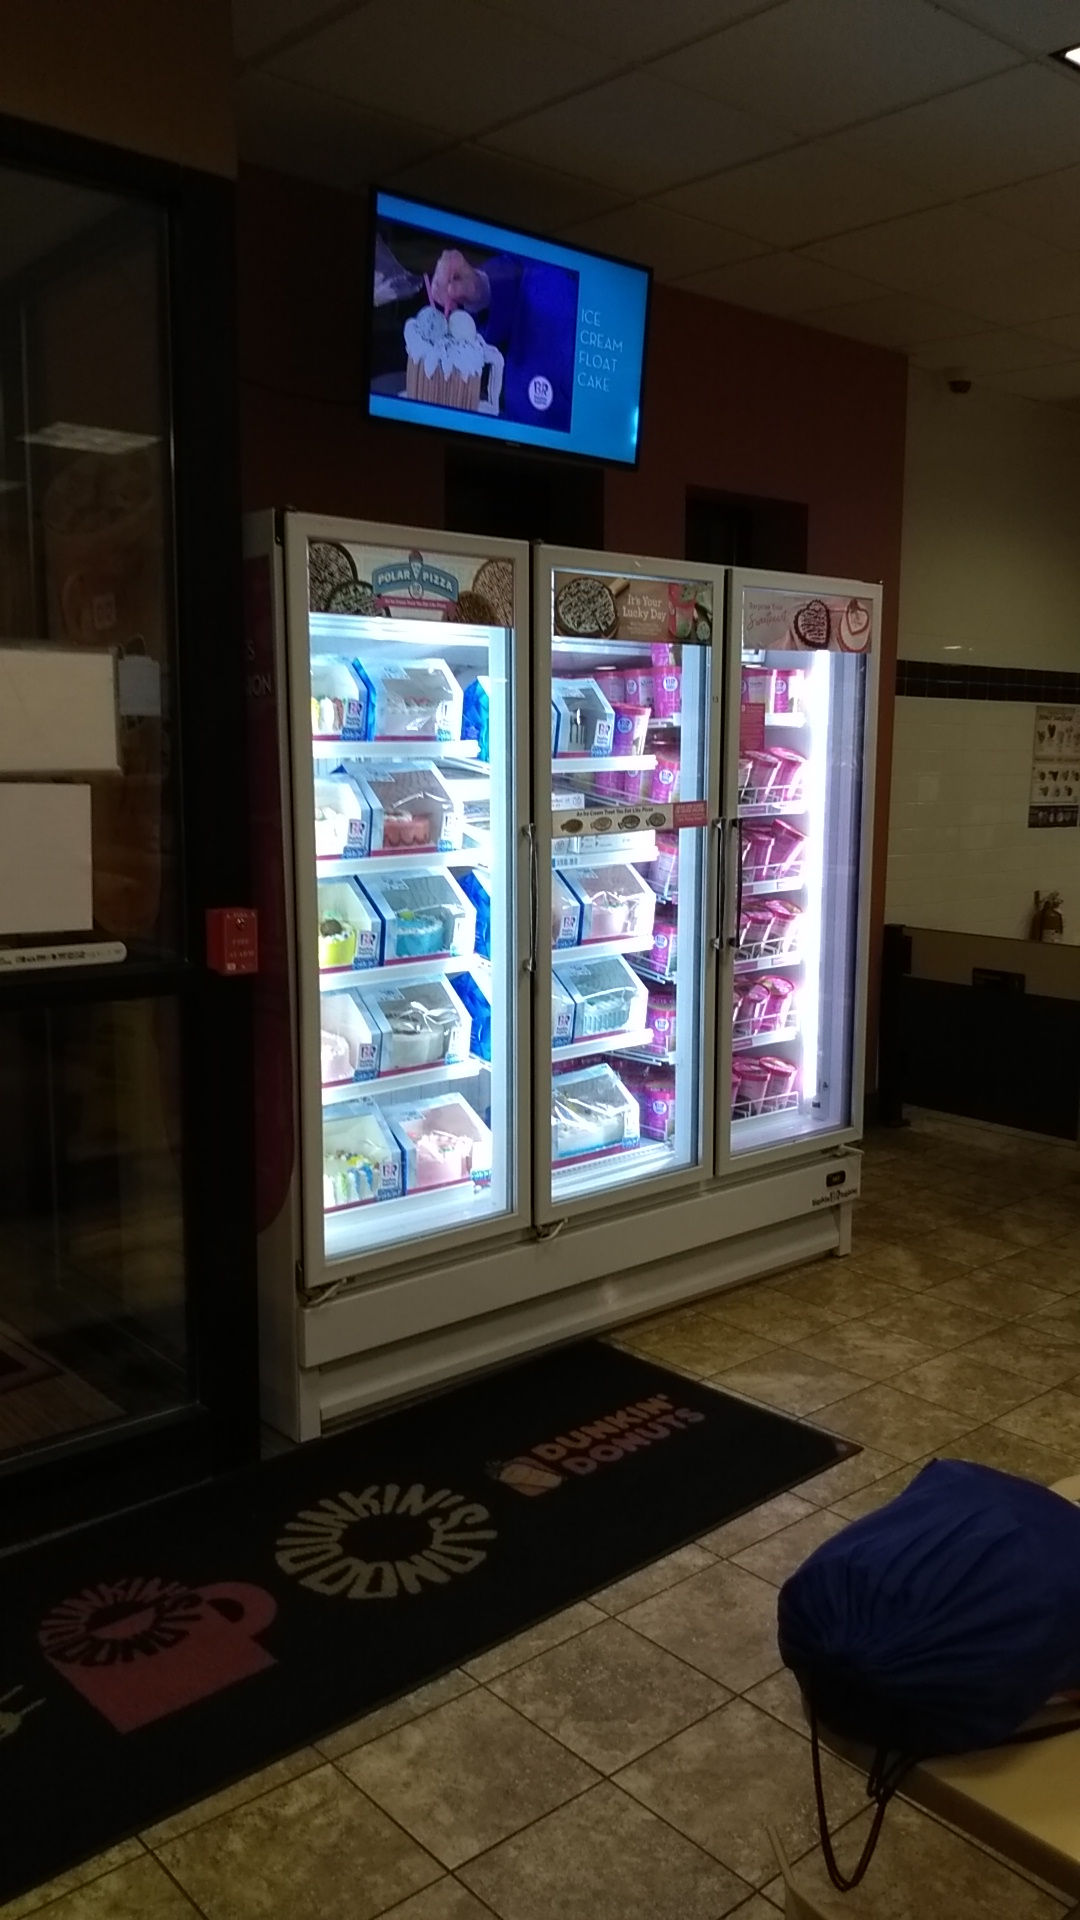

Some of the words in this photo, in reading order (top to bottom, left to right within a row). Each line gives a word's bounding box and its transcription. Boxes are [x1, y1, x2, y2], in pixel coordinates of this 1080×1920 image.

[581, 308, 601, 328] ICE
[579, 329, 624, 353] CREAM
[578, 352, 619, 372] FLOAT
[577, 372, 610, 392] CAKE
[376, 571, 411, 586] POLAR
[421, 573, 454, 592] PIZZA
[627, 594, 641, 605] It's
[642, 595, 663, 608] Your
[622, 605, 649, 620] Lucky
[650, 608, 667, 623] Day
[530, 1392, 674, 1461] DUNKIN'
[560, 1407, 706, 1476] DONUTS
